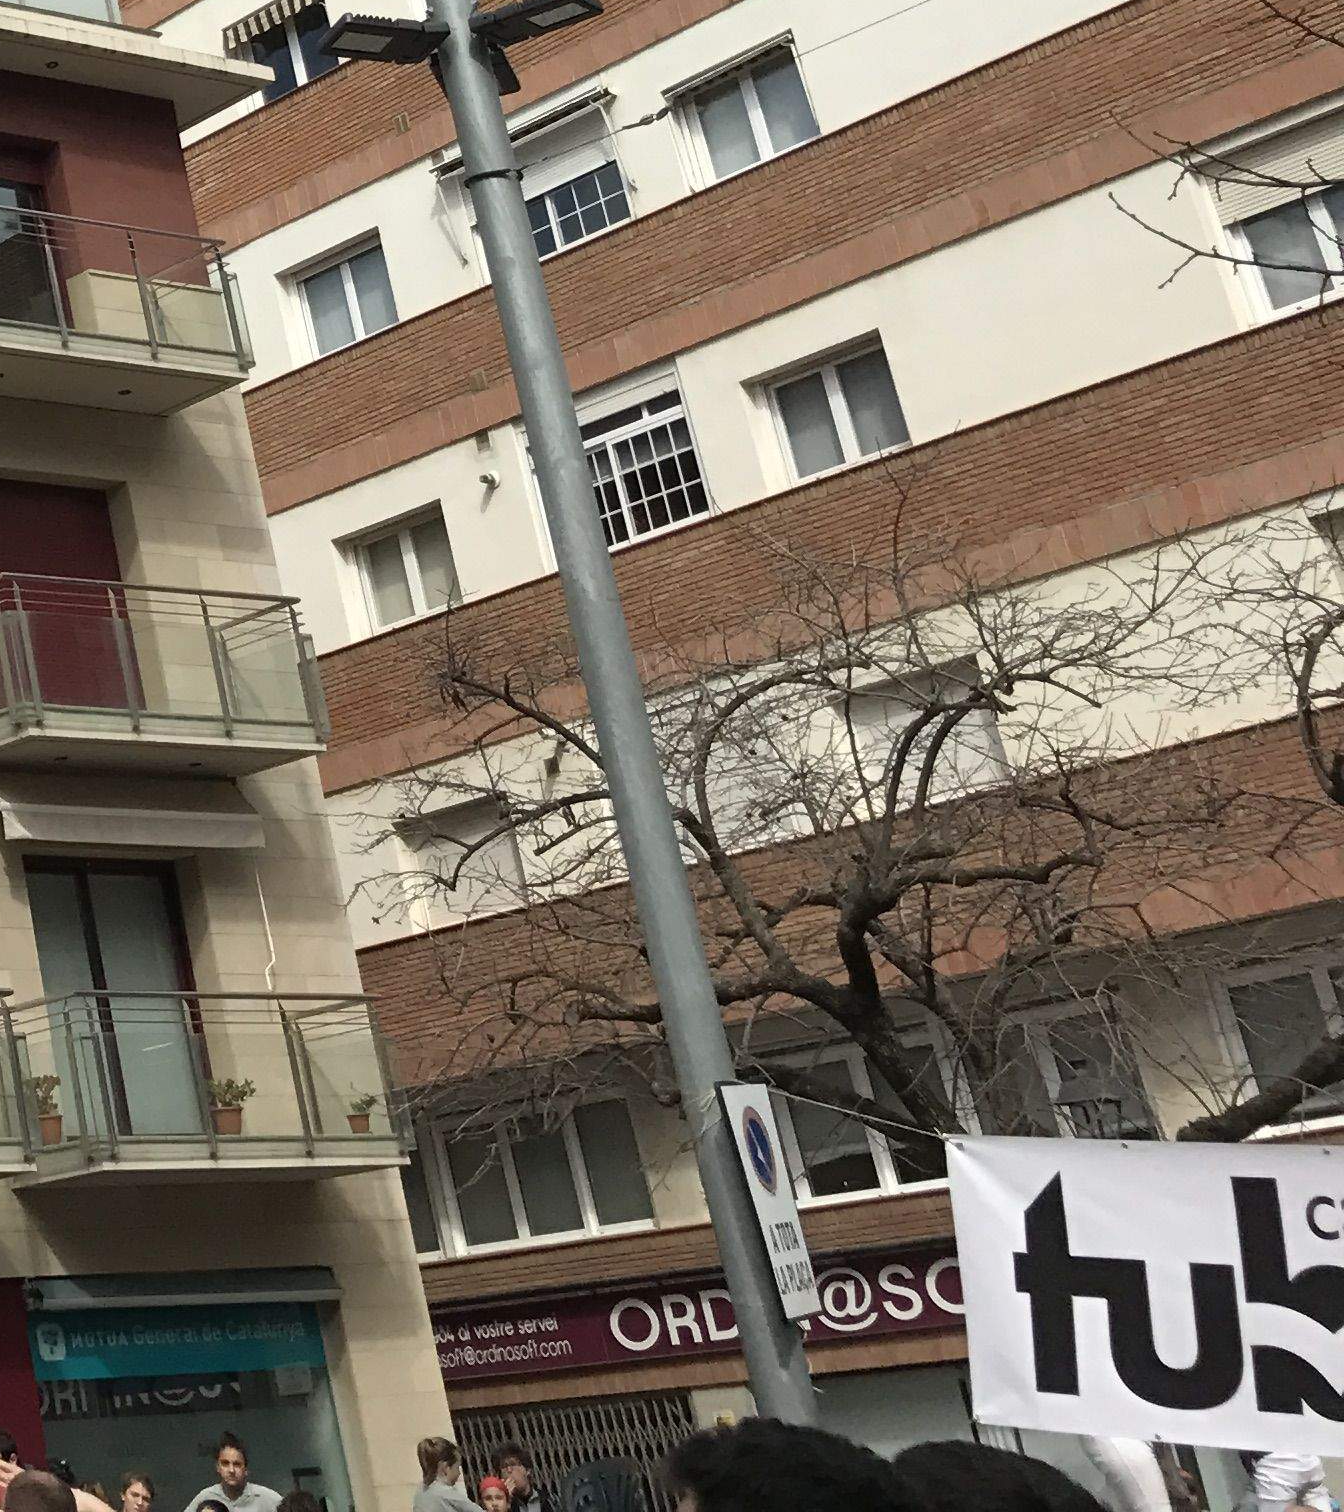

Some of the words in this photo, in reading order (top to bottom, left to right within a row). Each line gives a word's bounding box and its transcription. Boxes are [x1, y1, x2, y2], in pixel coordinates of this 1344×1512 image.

[769, 1224, 781, 1254] A
[775, 1221, 800, 1251] TOTA
[474, 1319, 514, 1339] vostre
[518, 1314, 559, 1335] servei
[438, 1339, 573, 1369] soft@ordinosoft.com
